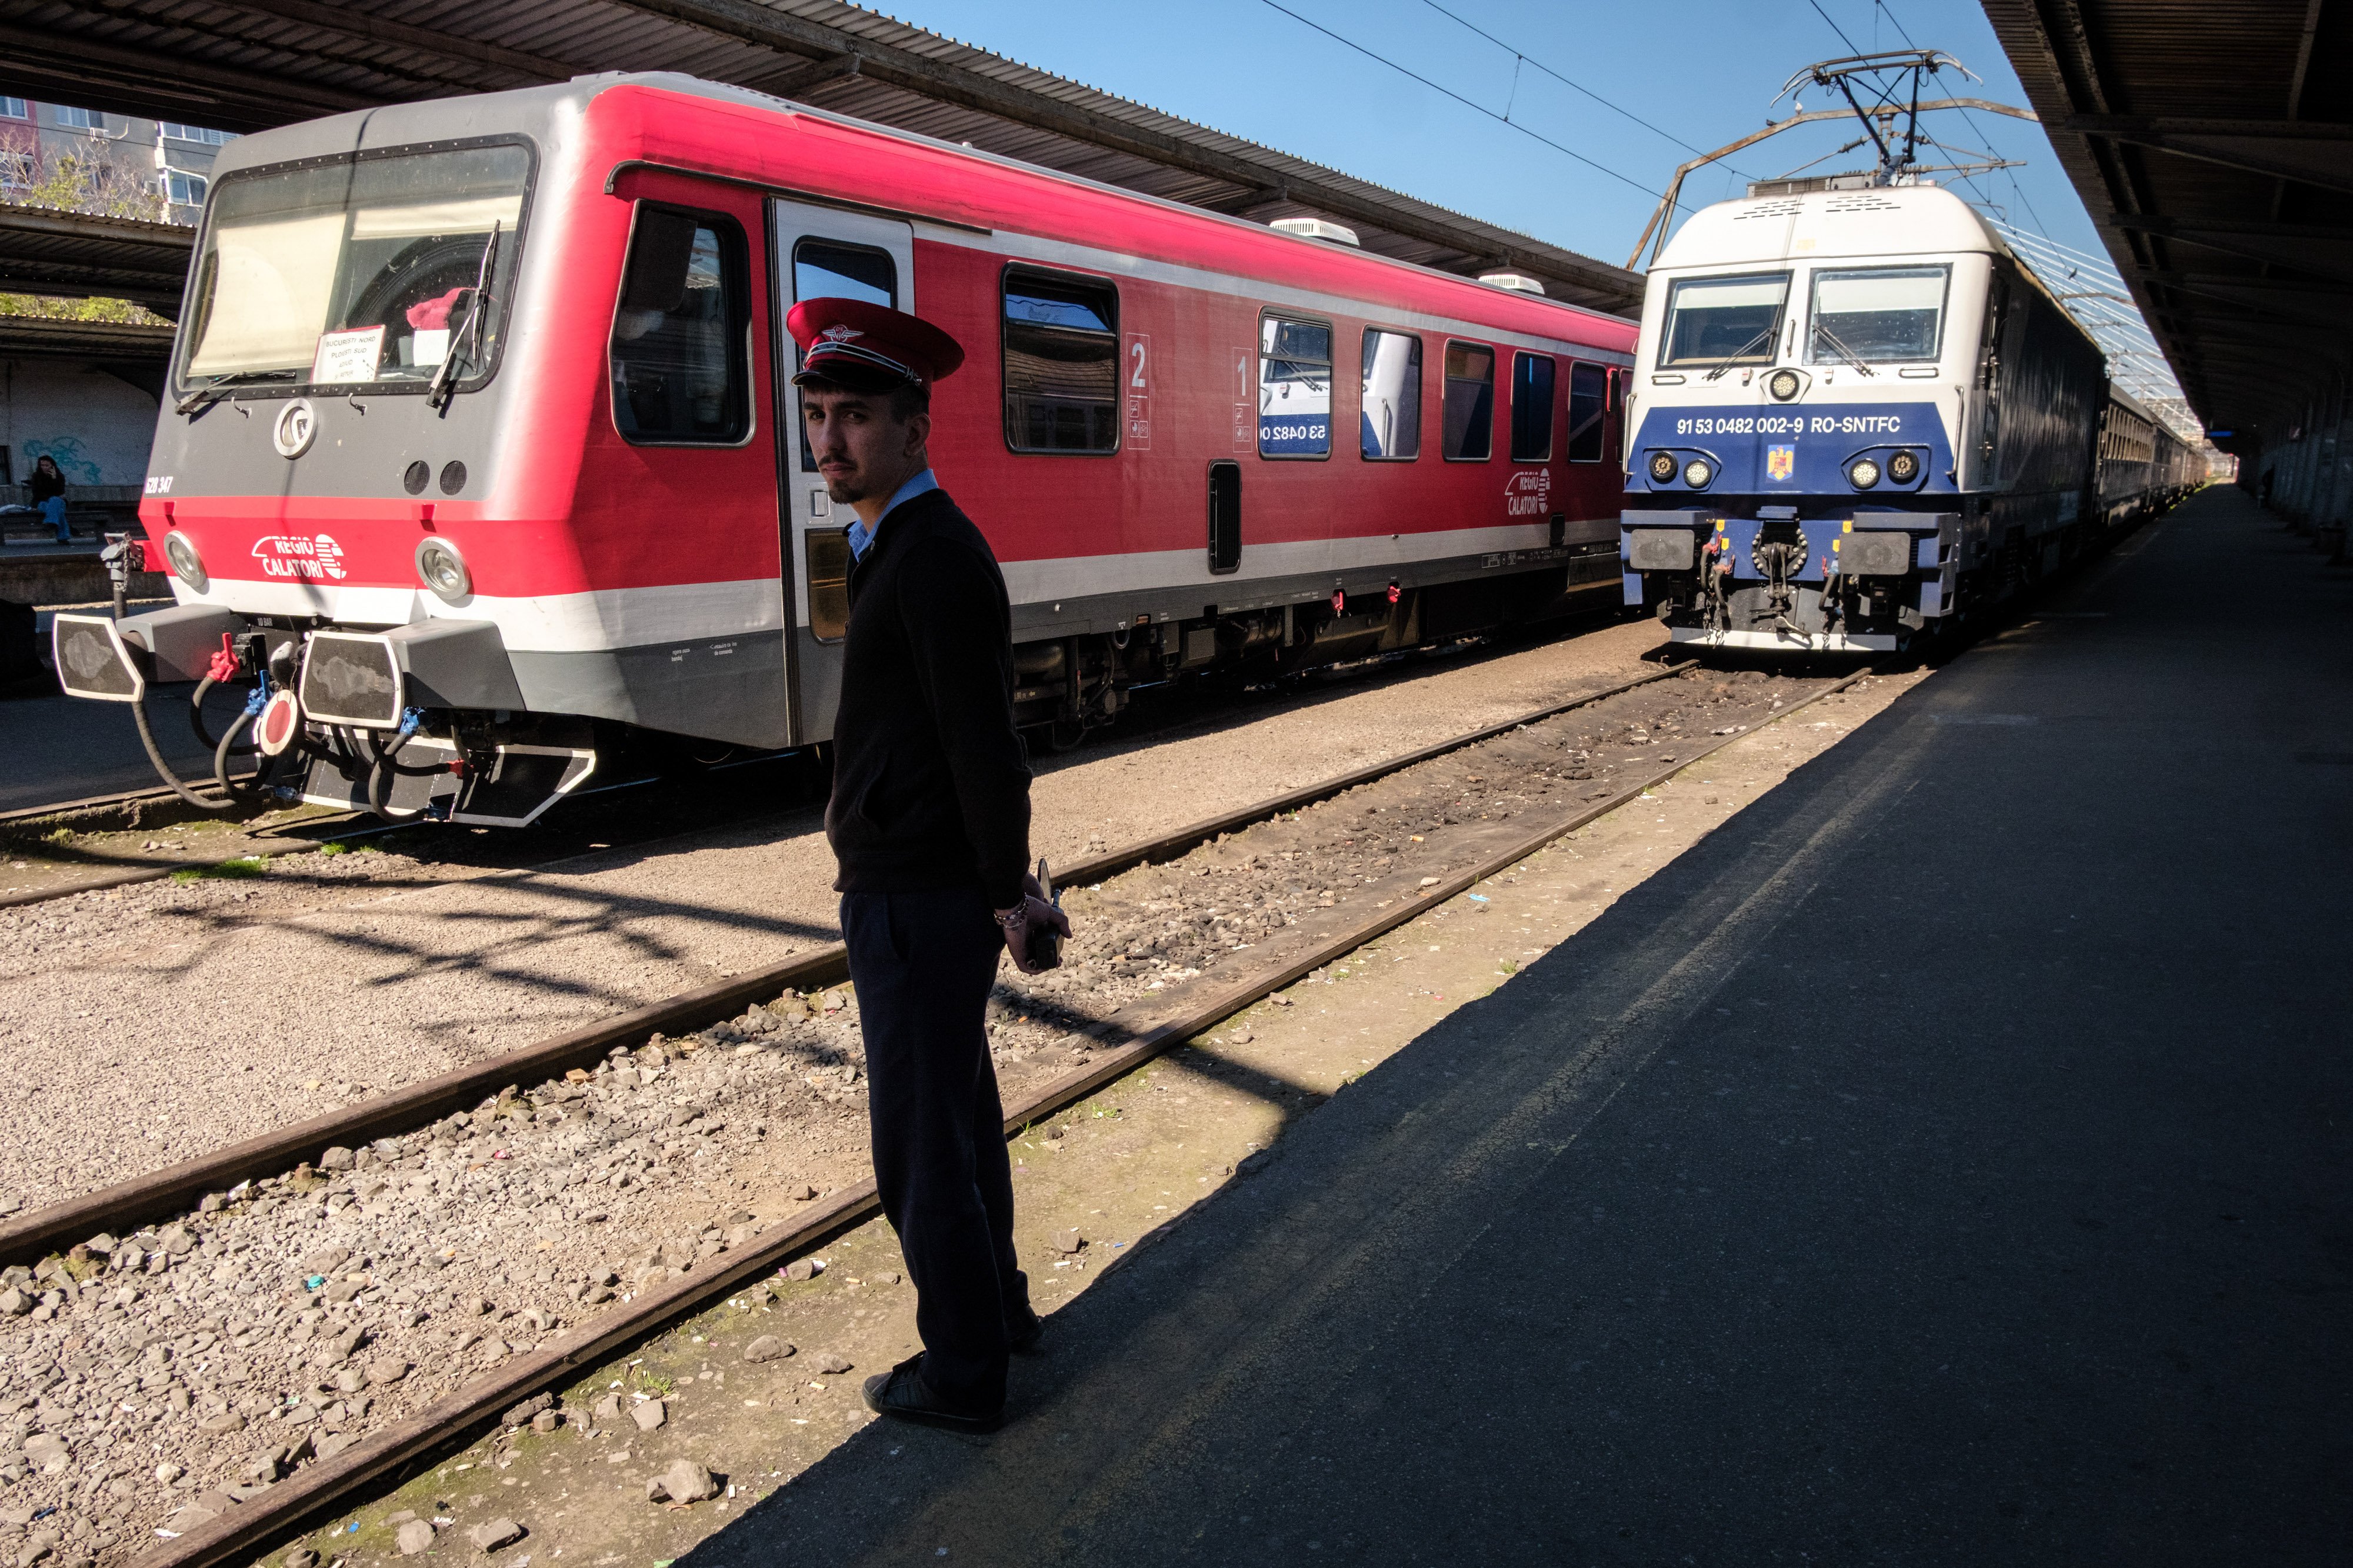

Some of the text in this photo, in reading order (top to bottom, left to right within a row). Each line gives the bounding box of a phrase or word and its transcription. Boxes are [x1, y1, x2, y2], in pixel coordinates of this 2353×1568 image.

[1132, 343, 1145, 387] 2
[1238, 356, 1246, 396] 1
[1677, 416, 1901, 434] 91 53 0482 002-9 RO-SNTFC
[145, 476, 174, 494] 628 347
[1519, 472, 1539, 491] REGIO
[272, 536, 314, 555] REGIO
[258, 618, 273, 626] 10 BAR
